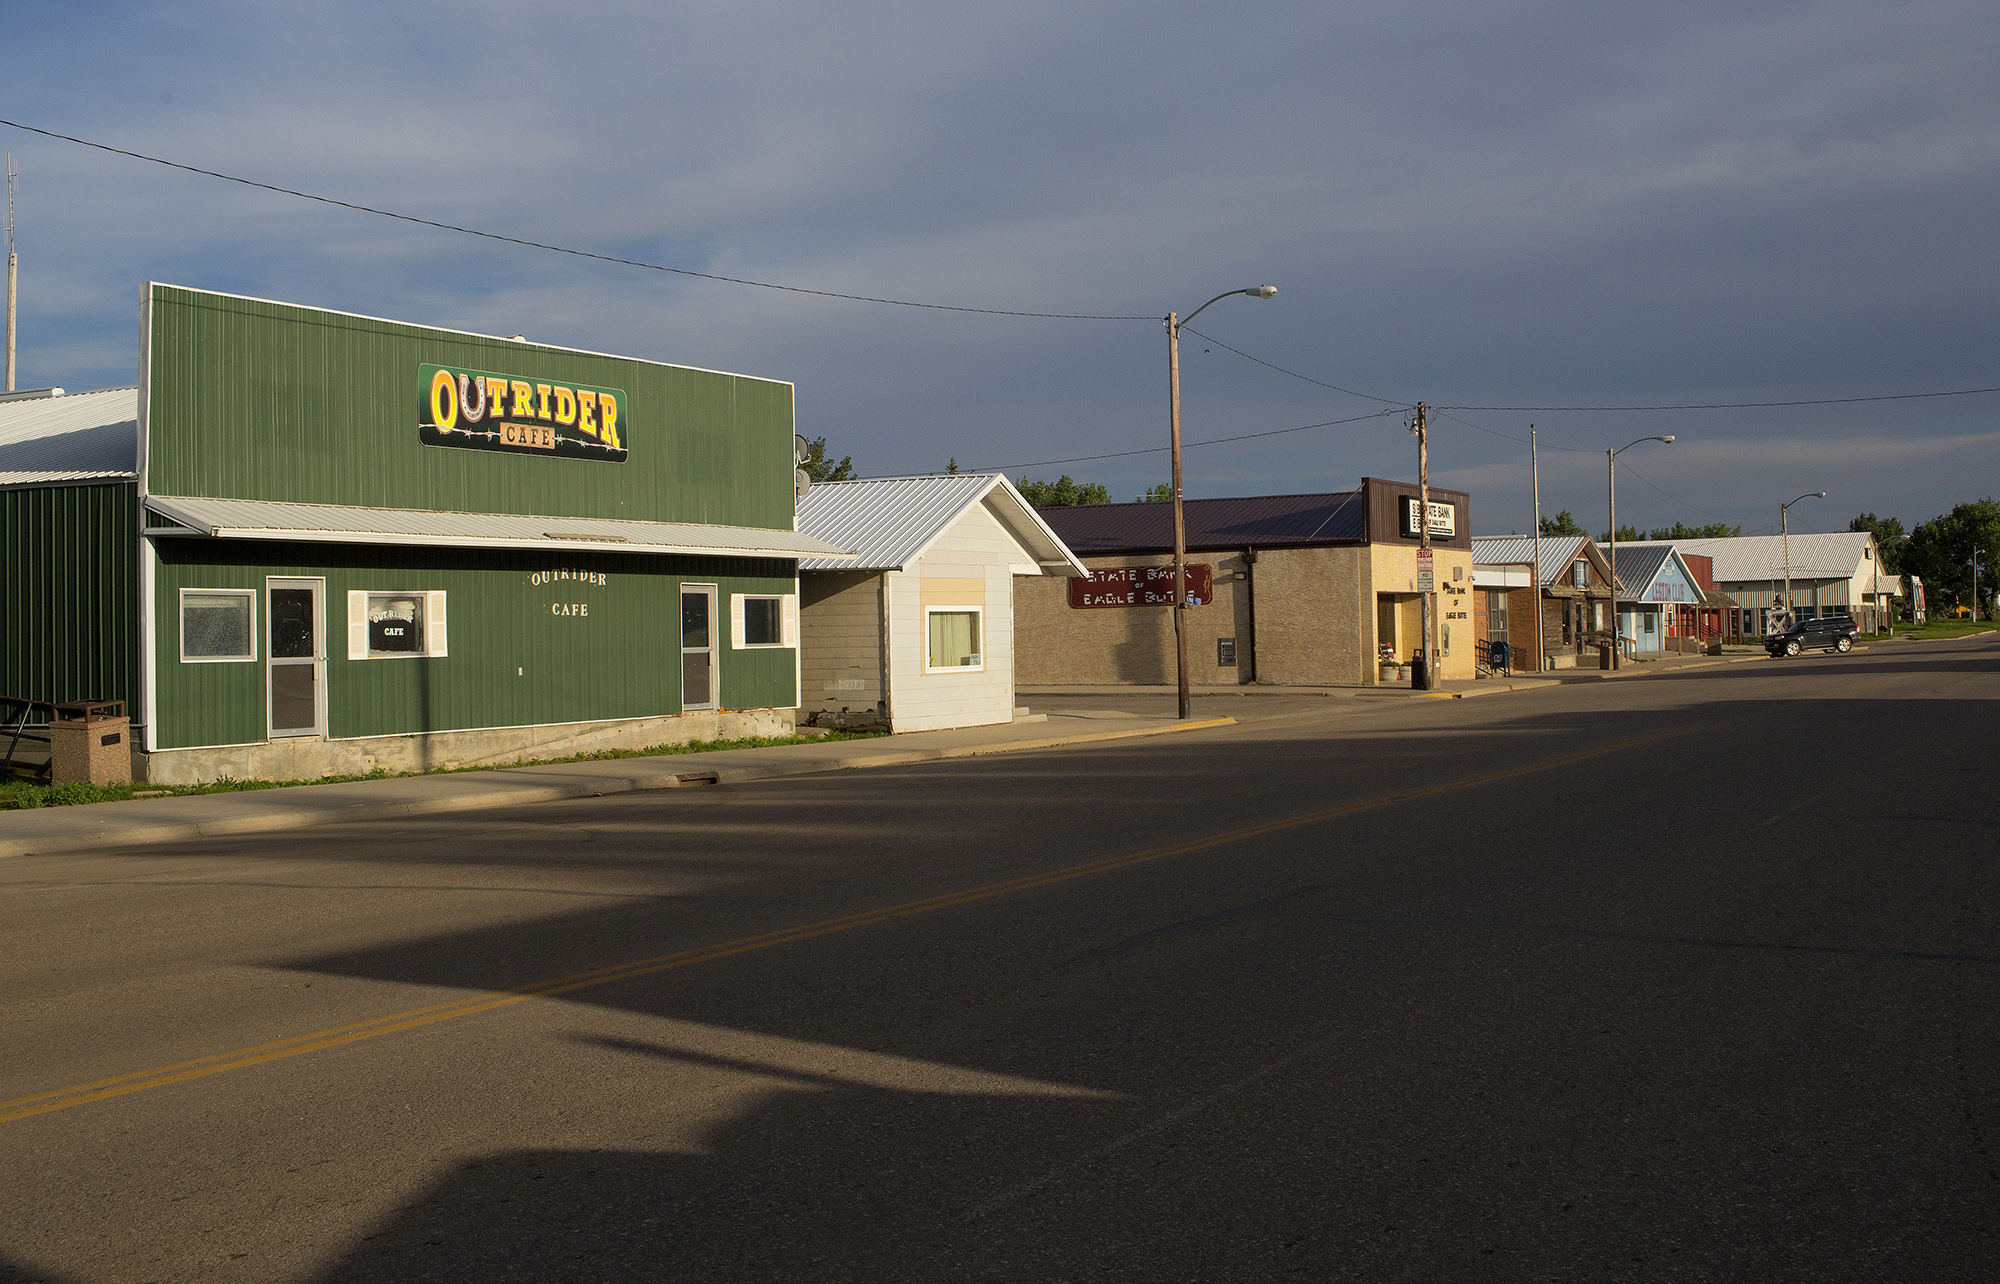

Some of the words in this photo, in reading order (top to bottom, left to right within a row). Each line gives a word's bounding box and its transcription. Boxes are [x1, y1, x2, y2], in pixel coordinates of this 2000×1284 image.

[430, 369, 620, 452] OUTRIDER
[506, 426, 550, 446] CAFE
[1417, 550, 1432, 558] STOP
[531, 568, 606, 586] OUTRIDER
[1087, 570, 1137, 583] STATE
[1083, 592, 1136, 605] EAGLE
[552, 603, 588, 616] CAFE
[384, 627, 404, 636] CAFE
